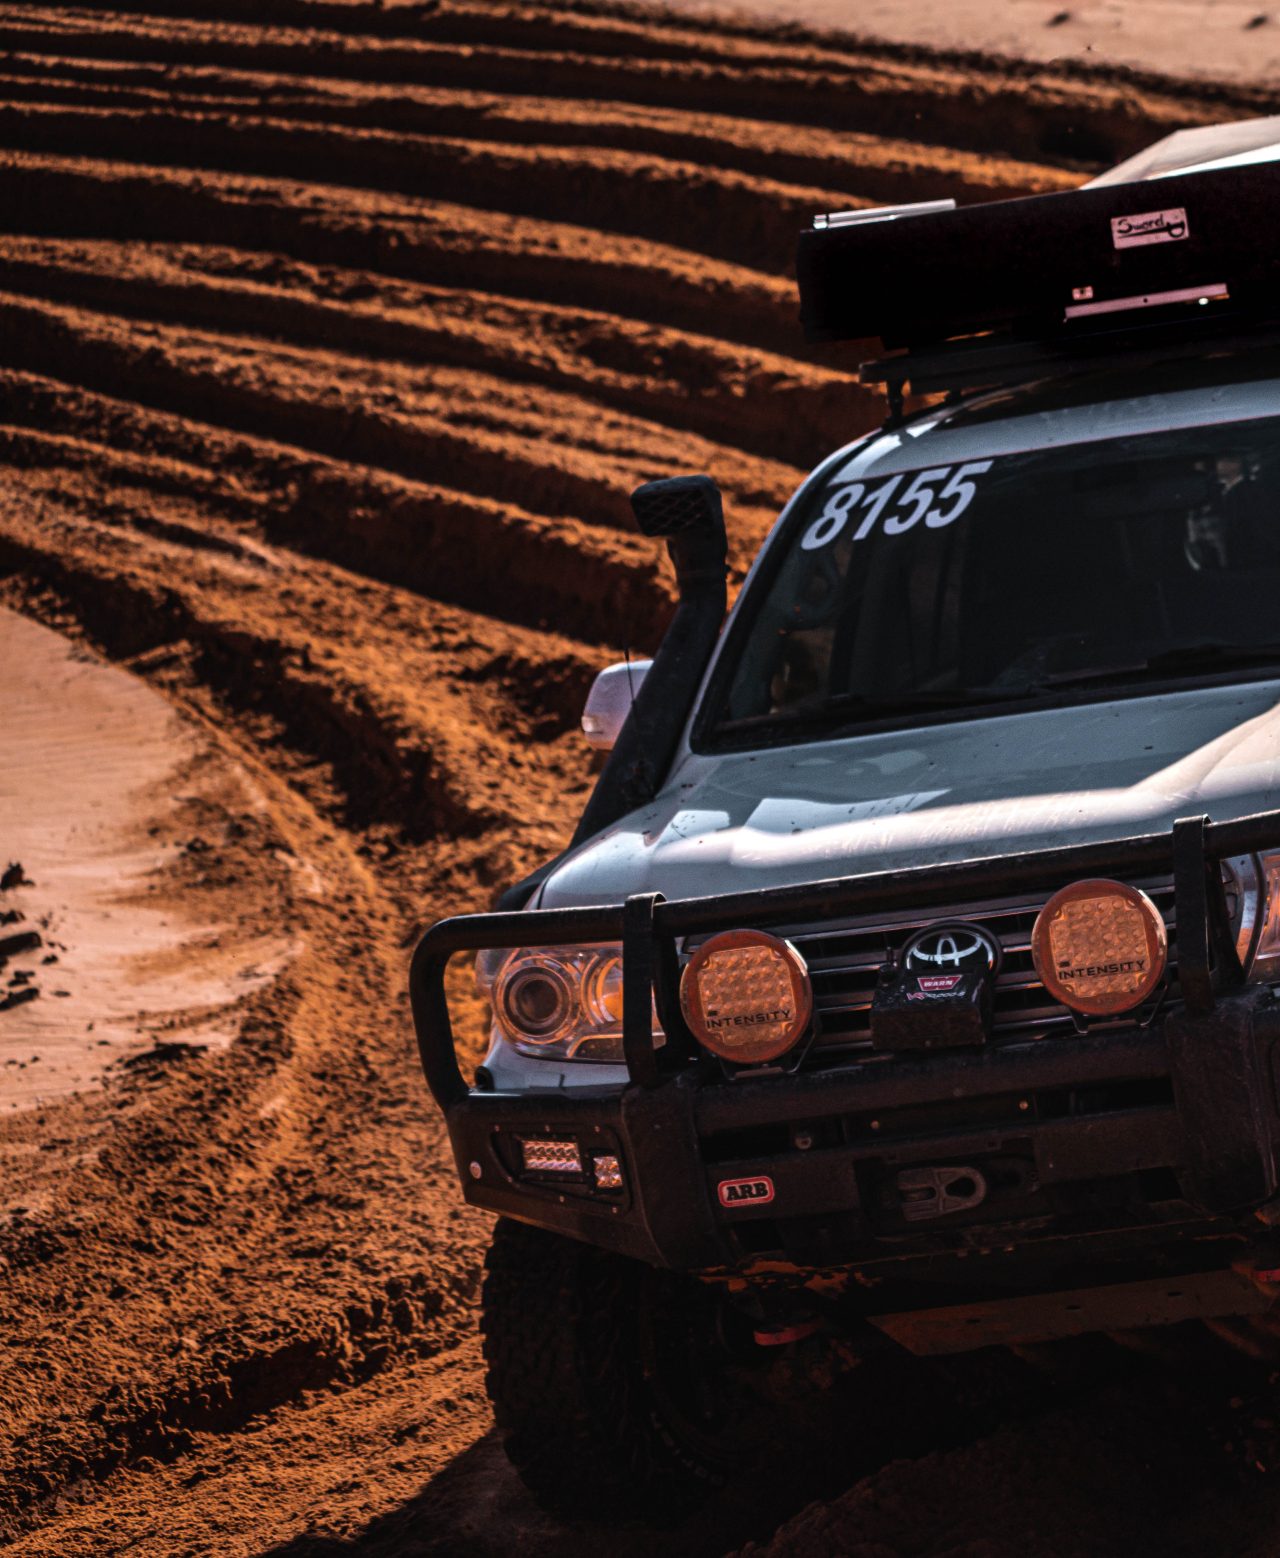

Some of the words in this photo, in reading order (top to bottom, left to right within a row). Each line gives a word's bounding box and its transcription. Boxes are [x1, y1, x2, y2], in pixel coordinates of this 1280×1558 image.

[1117, 213, 1164, 234] Sword
[801, 460, 994, 550] 8155
[1058, 959, 1145, 980] INTENSITY
[706, 1009, 791, 1029] INTENSITY
[726, 1182, 769, 1201] ARB
